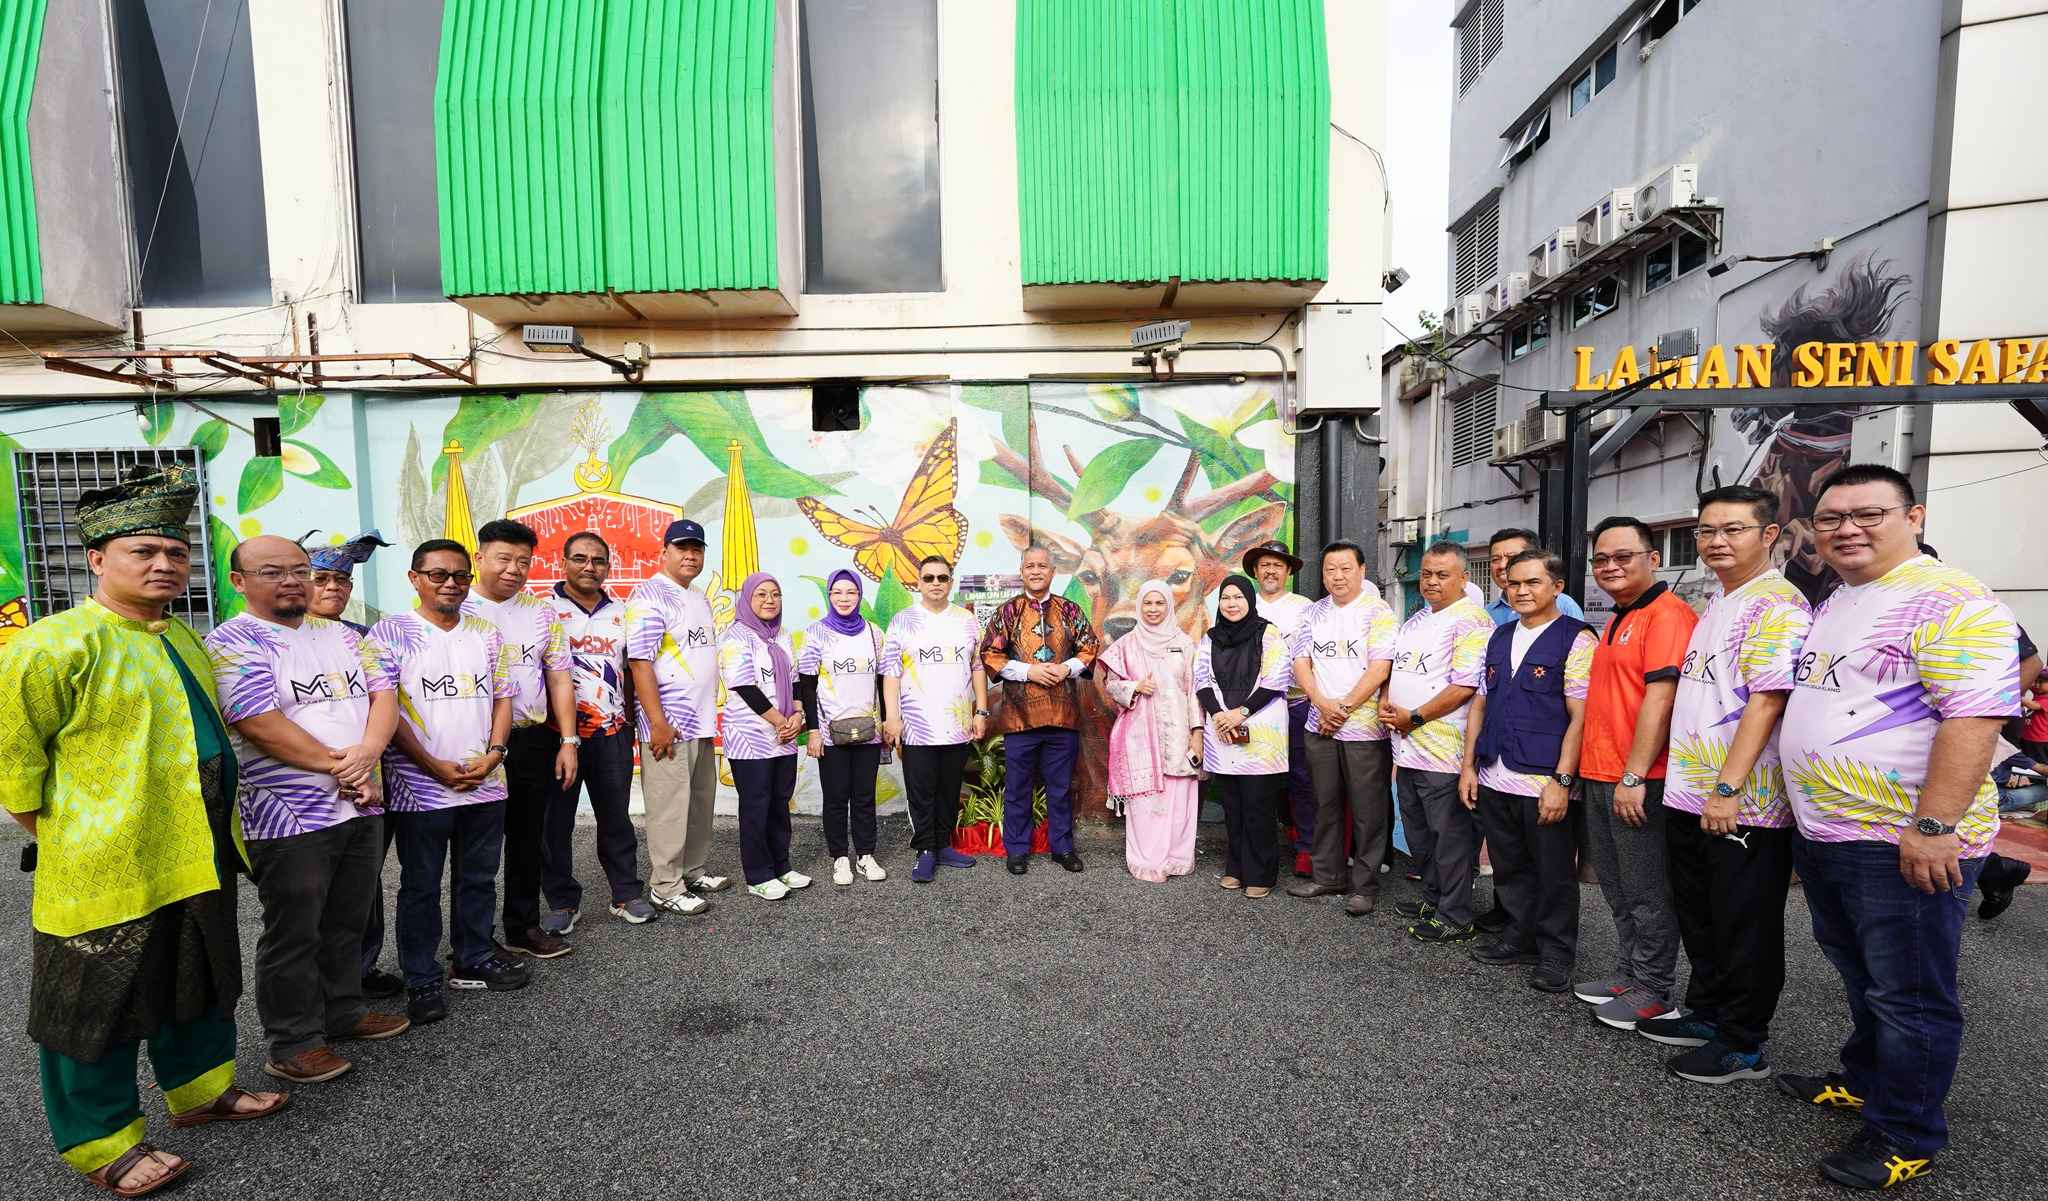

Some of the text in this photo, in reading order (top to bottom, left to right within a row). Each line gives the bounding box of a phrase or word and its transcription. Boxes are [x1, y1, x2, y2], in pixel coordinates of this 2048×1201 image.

[1572, 344, 1776, 391] LAMAN
[1792, 340, 1918, 387] SENI
[1682, 650, 1717, 681] BDK
[1795, 651, 1847, 688] BDK
